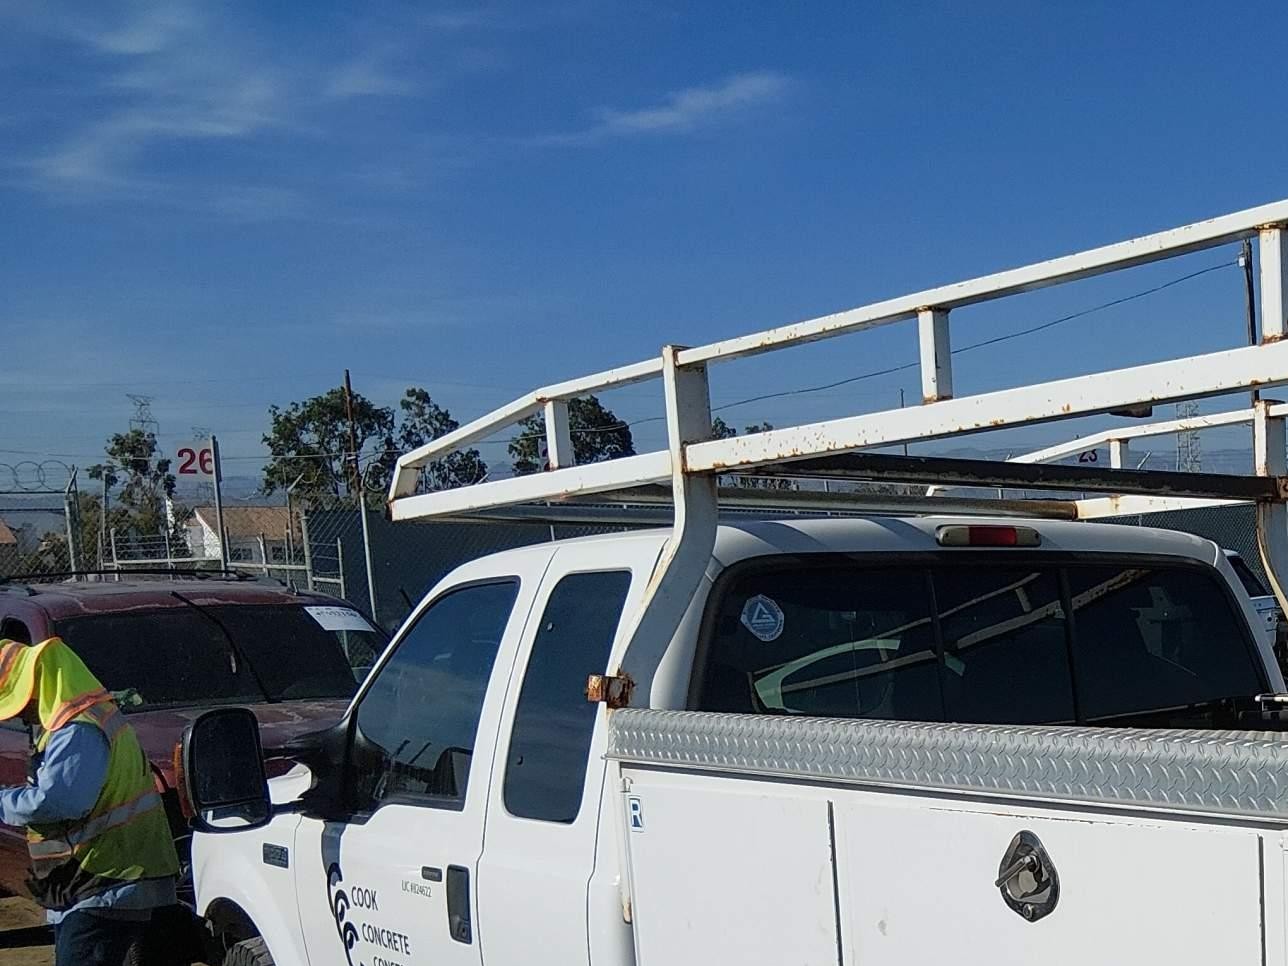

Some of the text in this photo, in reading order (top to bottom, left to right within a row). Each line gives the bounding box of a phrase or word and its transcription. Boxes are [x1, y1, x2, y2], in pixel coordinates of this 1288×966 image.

[178, 448, 213, 475] 26
[351, 886, 379, 911] COOK
[361, 922, 411, 956] CONCRETE
